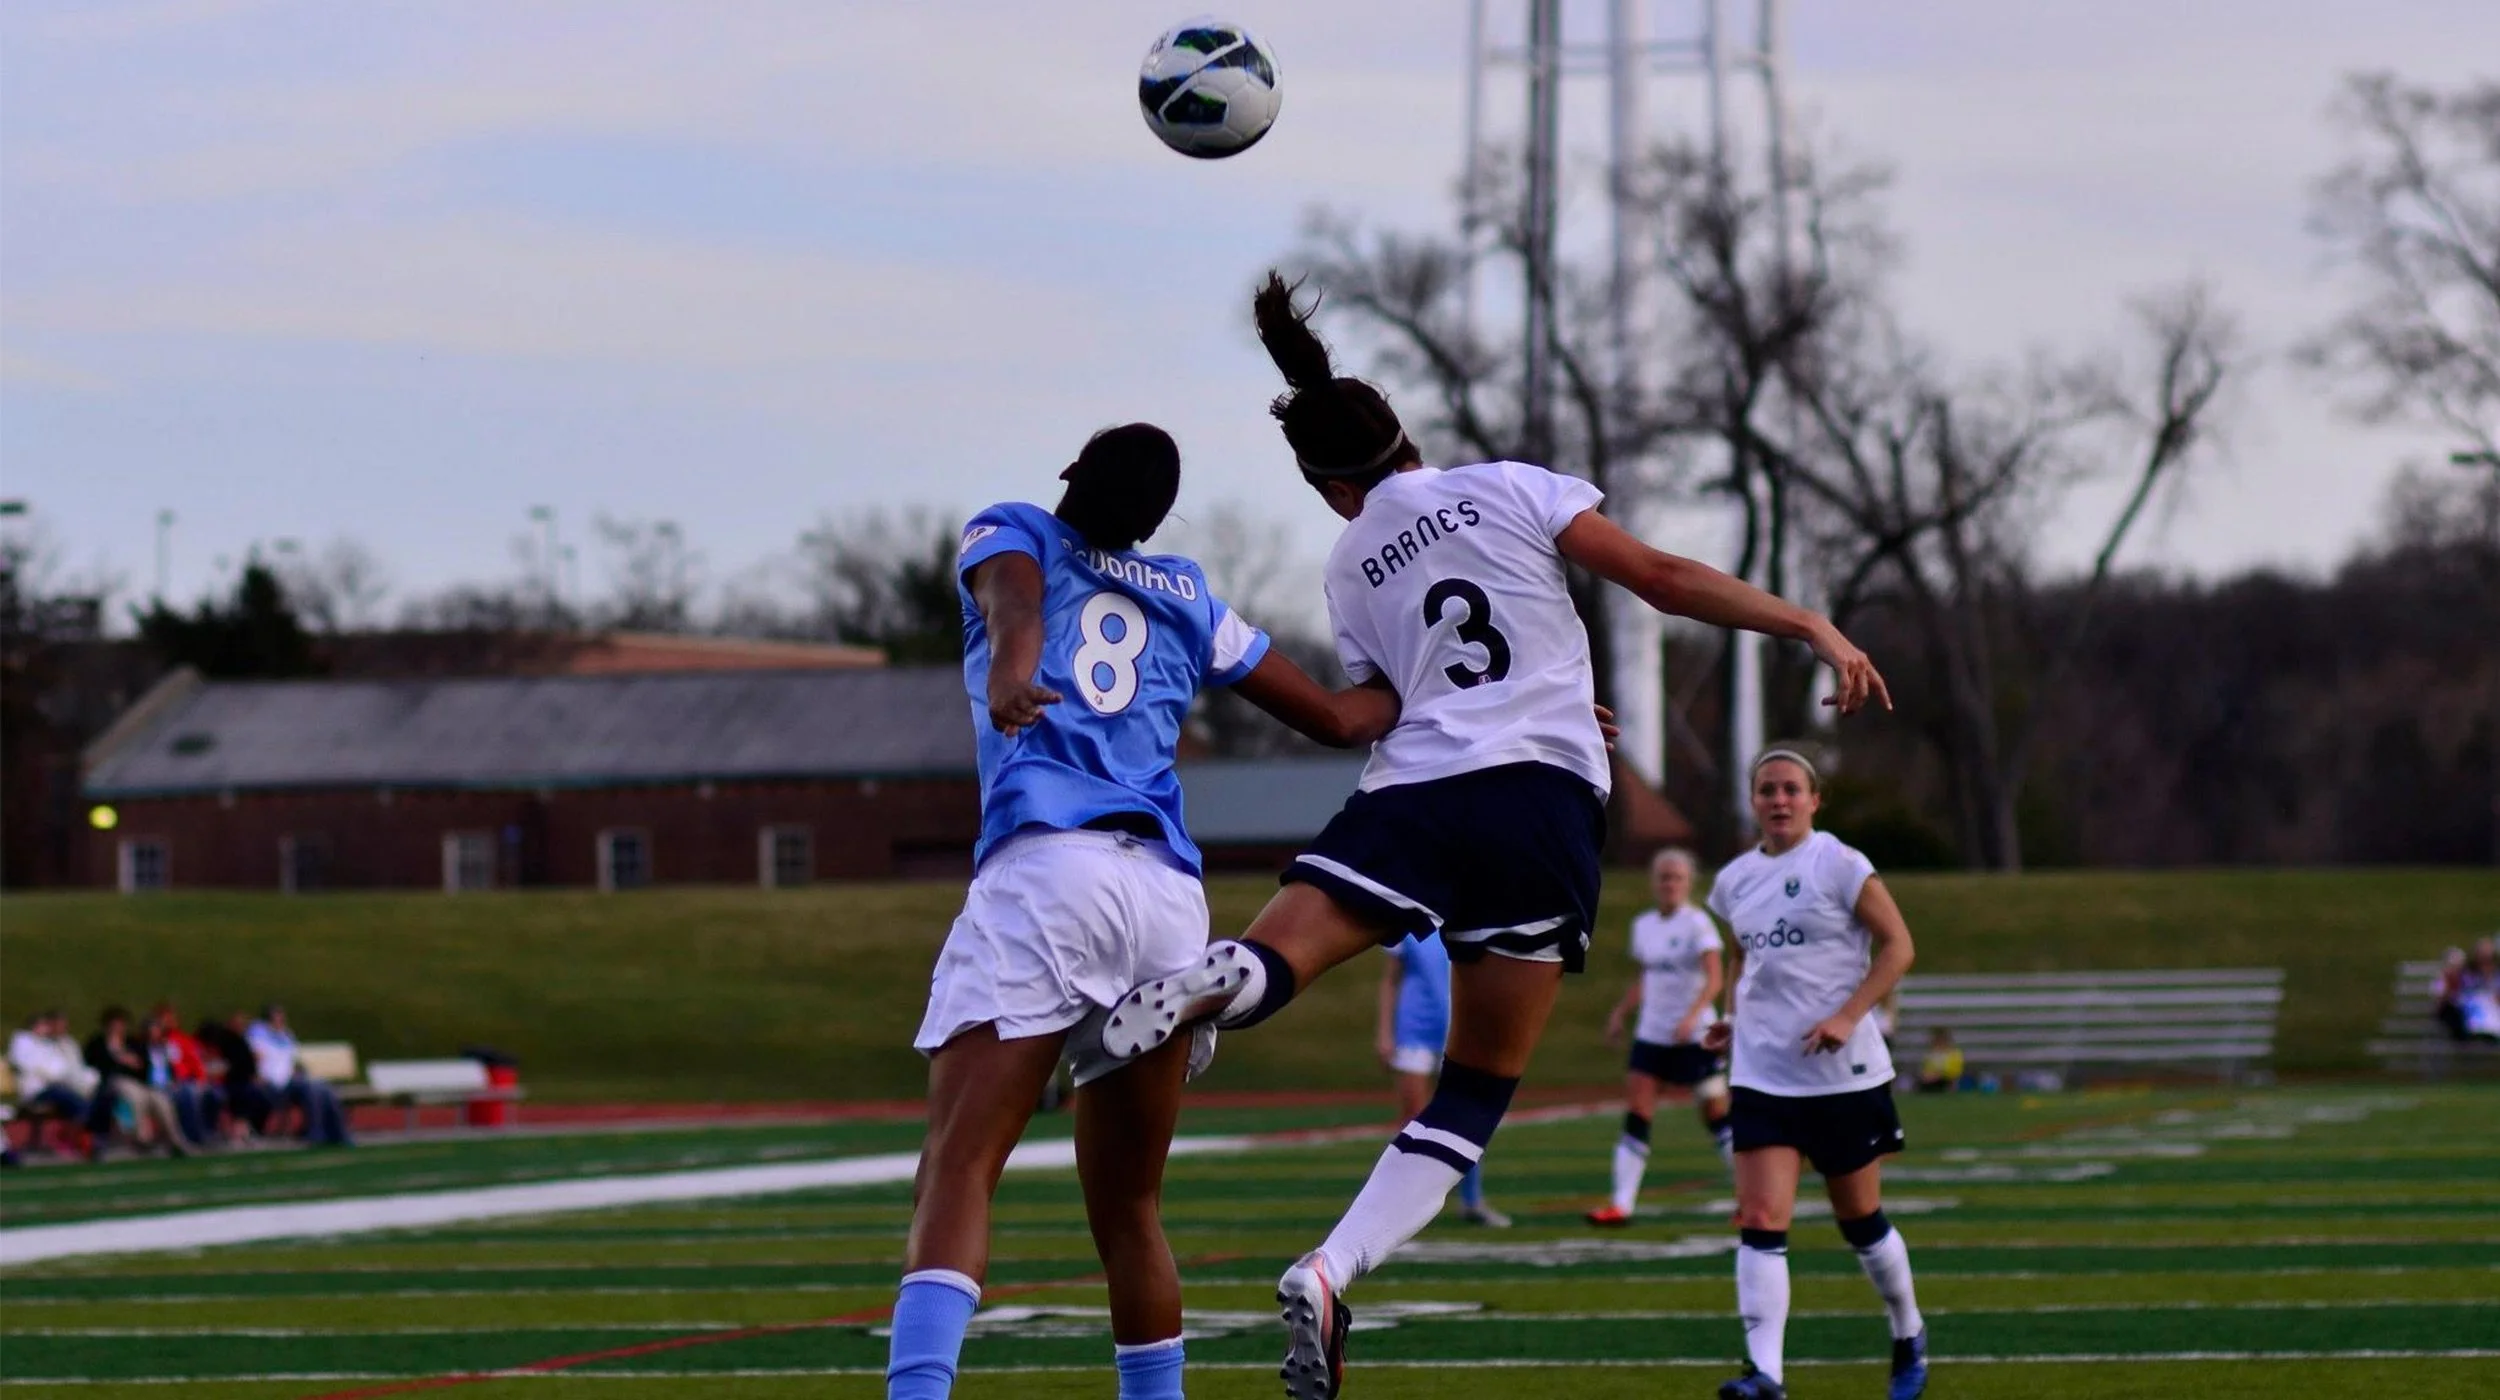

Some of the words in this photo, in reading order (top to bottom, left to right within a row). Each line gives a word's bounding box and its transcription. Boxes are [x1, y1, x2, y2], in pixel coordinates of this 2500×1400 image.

[1361, 500, 1480, 588] BARNES
[1072, 591, 1149, 716] 8
[1423, 578, 1511, 690] 3
